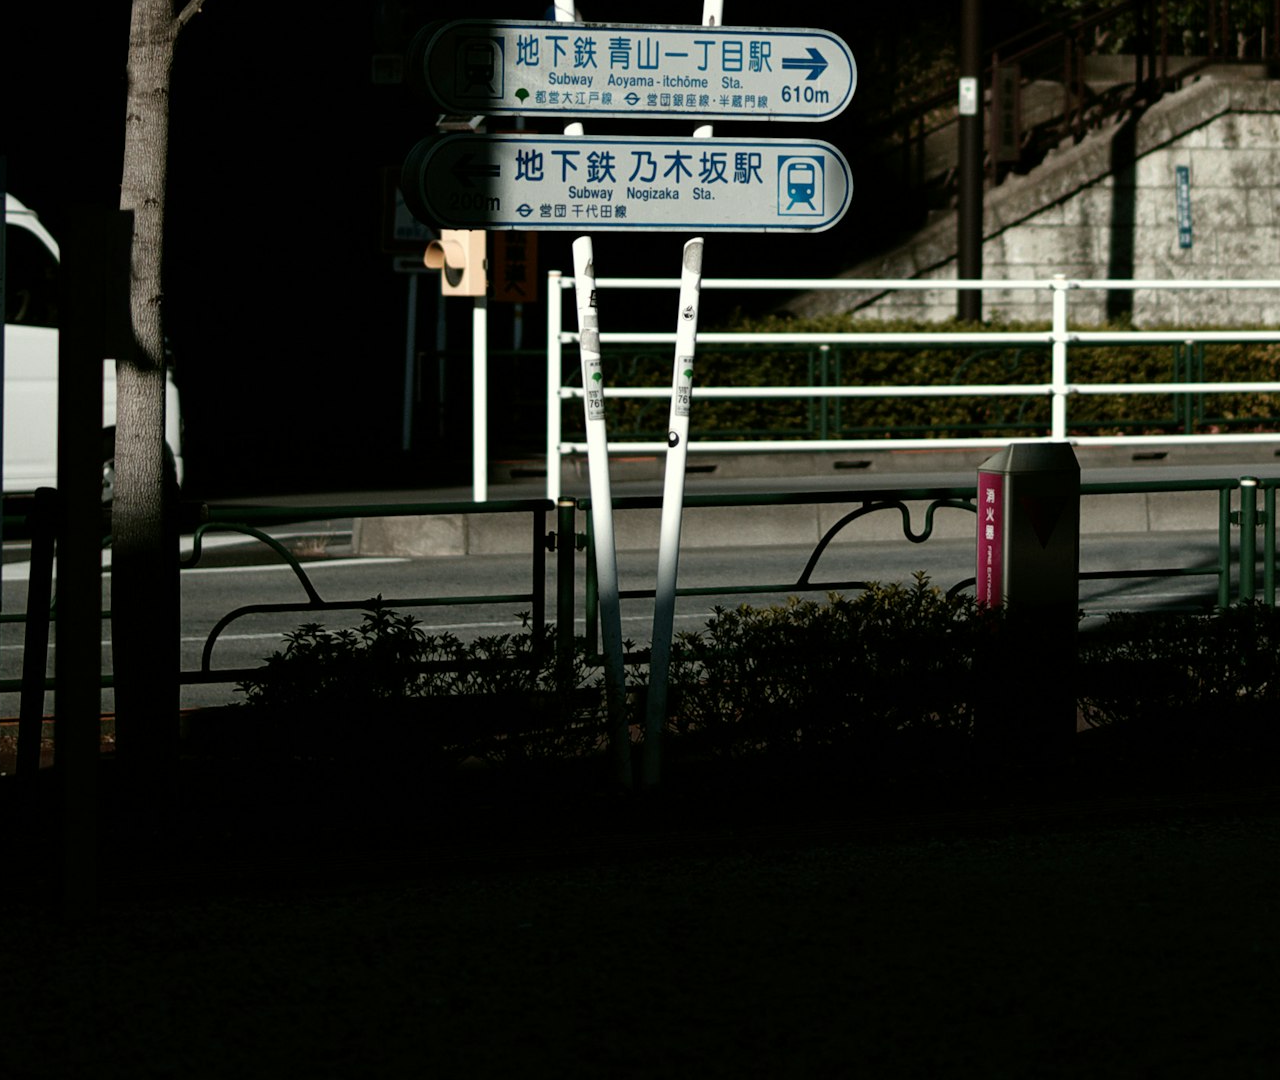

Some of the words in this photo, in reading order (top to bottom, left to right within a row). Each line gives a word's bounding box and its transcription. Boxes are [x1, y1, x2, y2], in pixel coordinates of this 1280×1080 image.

[515, 34, 598, 69] 地下鉄
[608, 36, 773, 73] 青山一丁目駅
[548, 72, 594, 88] Subway
[721, 76, 744, 89] Sta.
[535, 90, 613, 105] 都営大江戸線
[781, 85, 829, 104] 610m
[514, 149, 617, 183] 地下鉄
[628, 149, 763, 184] 乃木坂駅
[449, 192, 500, 212] 200m
[568, 185, 613, 201] Subway
[626, 187, 679, 201] Nogizaka
[692, 187, 716, 200] Sta.
[986, 488, 995, 540] 消火器
